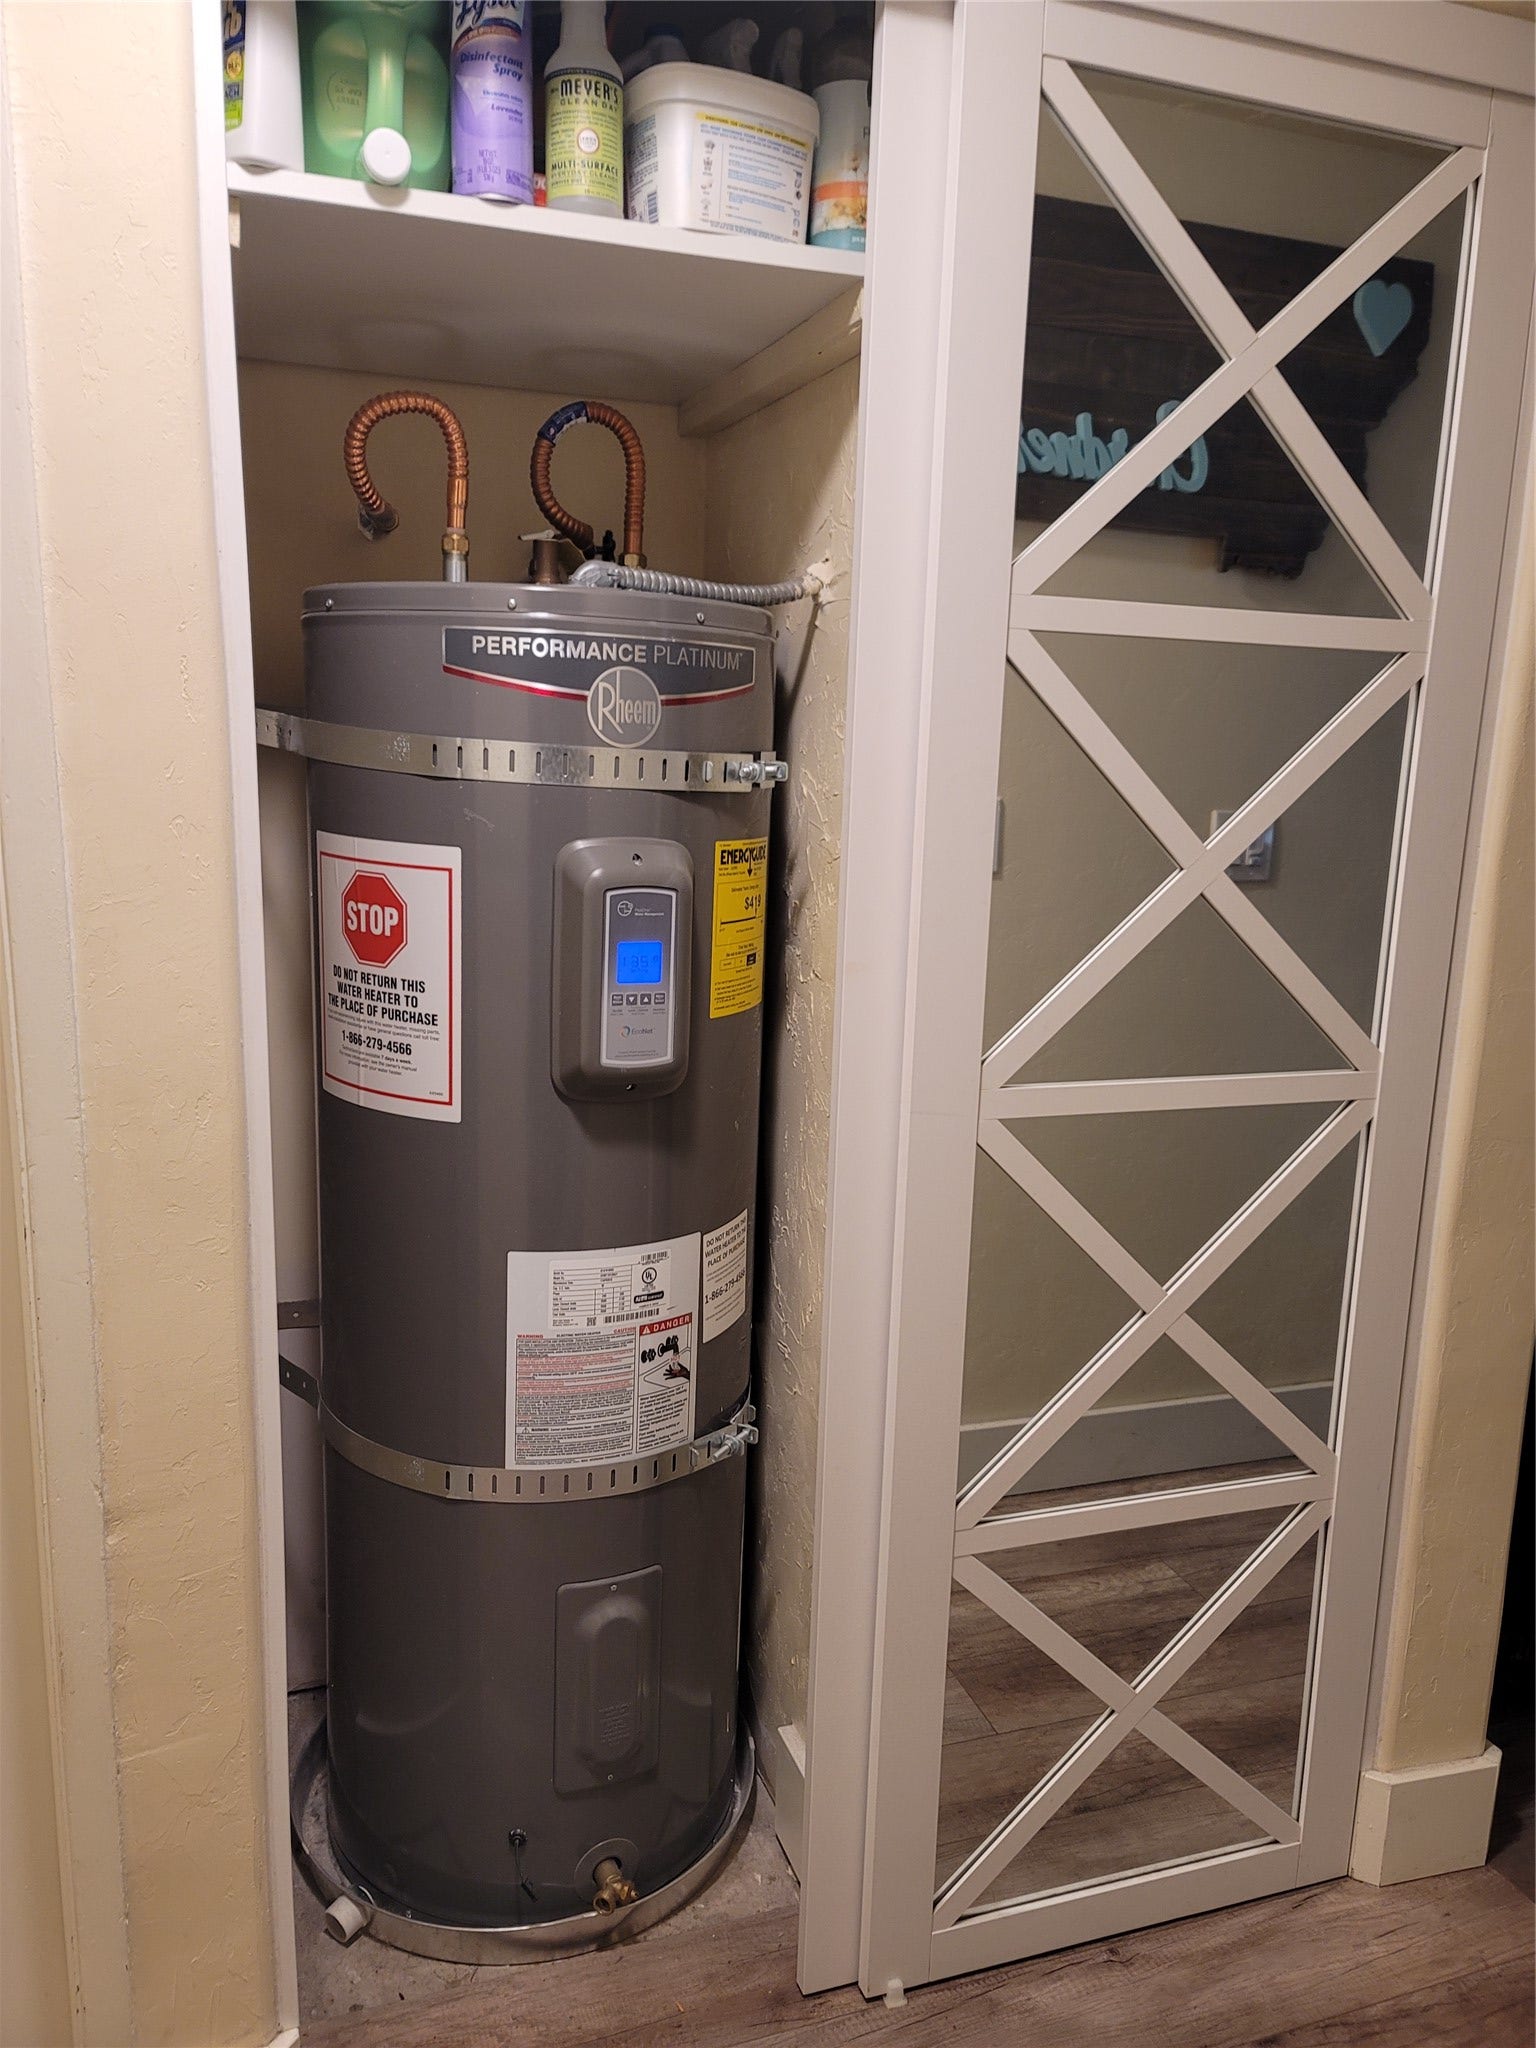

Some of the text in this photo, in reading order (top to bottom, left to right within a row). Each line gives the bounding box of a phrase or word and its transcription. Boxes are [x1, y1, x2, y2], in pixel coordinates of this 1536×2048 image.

[460, 50, 524, 69] Disinfectant
[493, 63, 522, 82] Spray
[560, 79, 618, 104] MEYER'S
[491, 104, 523, 116] Lavender
[560, 98, 618, 112] CLEAN DAY
[551, 160, 618, 177] MULTI-SURFACE
[472, 635, 647, 663] PERFORMANCE
[597, 670, 656, 734] Rheem
[744, 894, 761, 910] $419
[346, 900, 399, 937] STOP
[333, 965, 425, 993] DO NOT RETURN THIS
[337, 982, 418, 1008] WATER HEATER TO
[328, 993, 339, 1007] THE
[341, 998, 364, 1014] PLACE
[367, 1004, 378, 1017] OF
[382, 1007, 438, 1026] PURCHASE
[342, 1030, 412, 1055] 1-866-279-4566
[705, 1245, 722, 1258] WATER
[722, 1235, 737, 1250] HEATER
[706, 1236, 714, 1248] DO
[715, 1232, 725, 1244] NOT
[725, 1223, 740, 1237] RETURN
[708, 1256, 722, 1268] PLACE
[704, 1268, 746, 1304] 1-866-279-4566
[653, 1315, 690, 1332] DANGER
